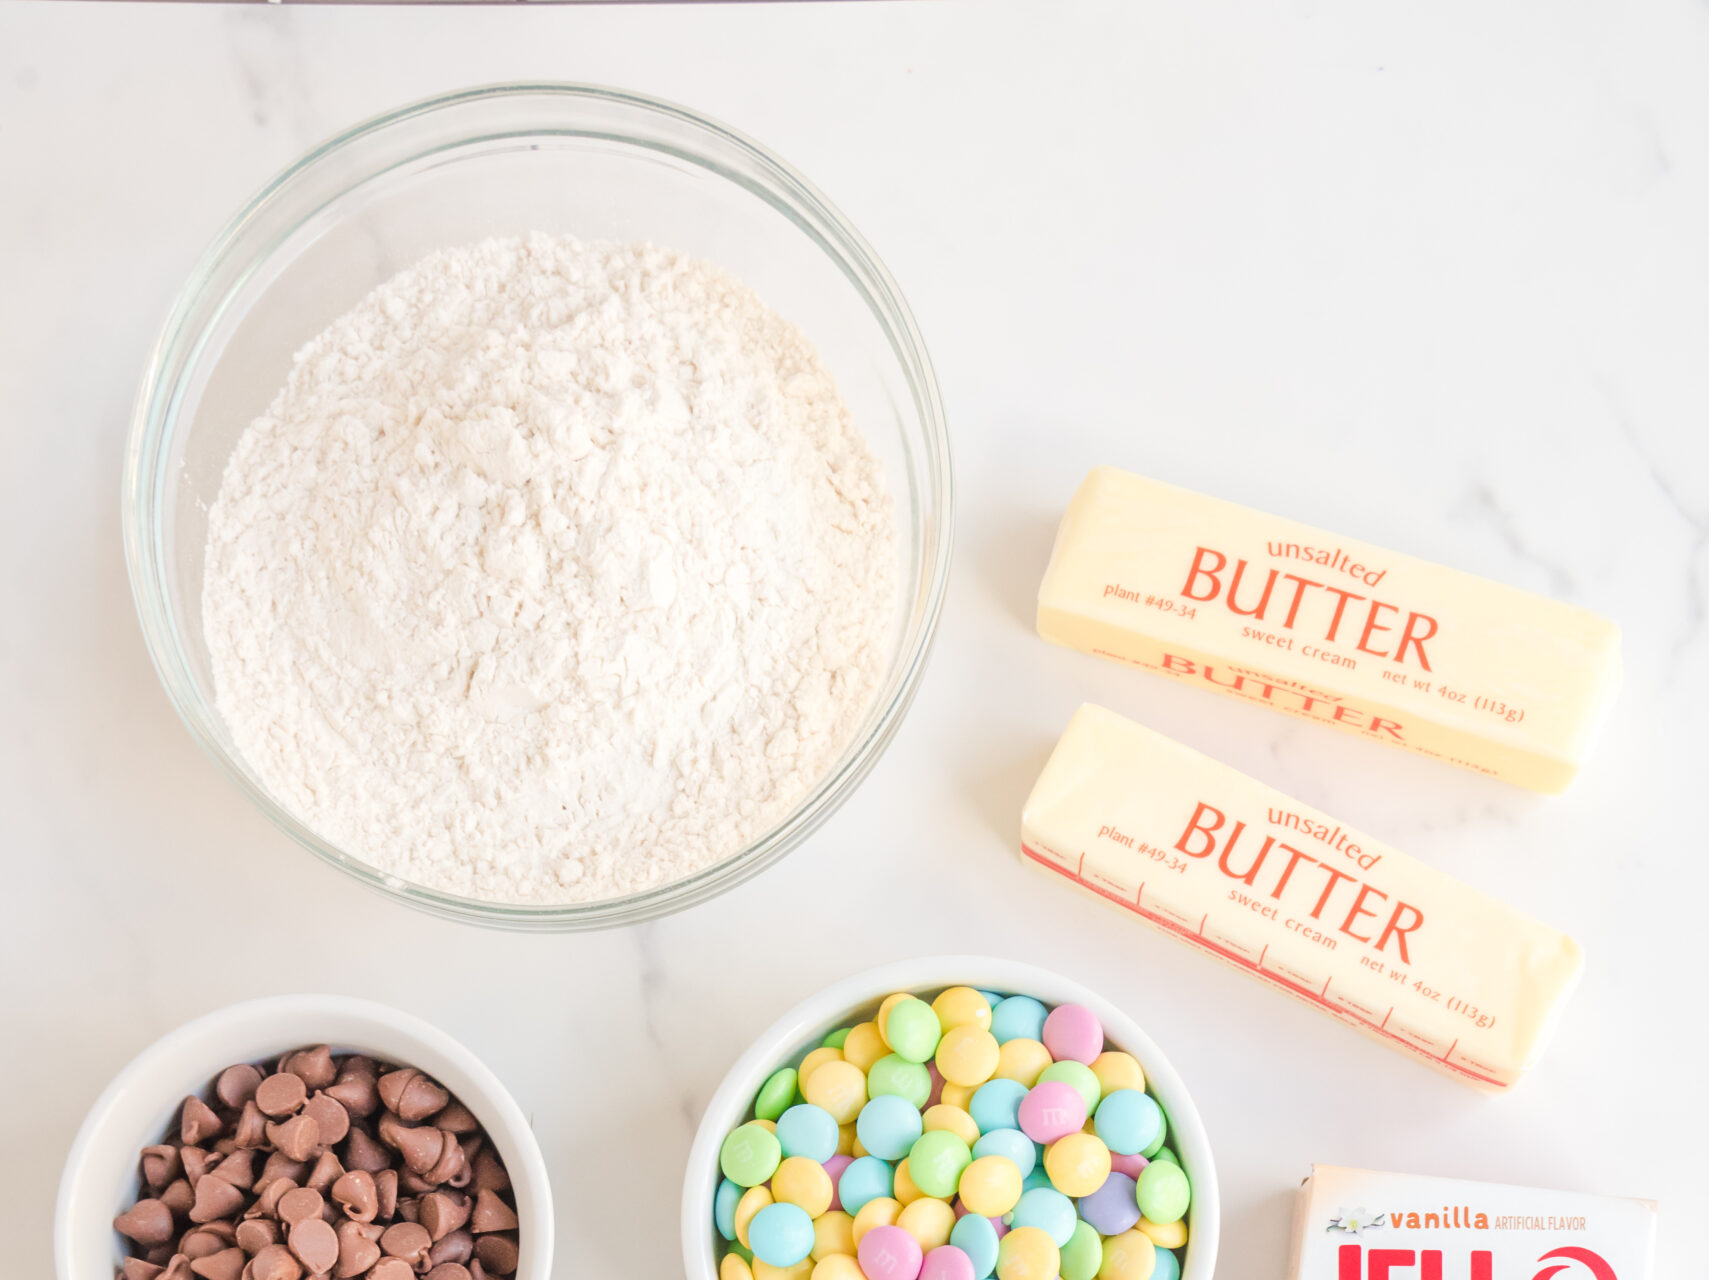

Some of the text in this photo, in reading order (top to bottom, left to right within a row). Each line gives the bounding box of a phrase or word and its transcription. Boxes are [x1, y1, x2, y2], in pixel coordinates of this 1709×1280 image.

[1267, 540, 1387, 589] unsalted
[1103, 582, 1197, 621] plant #49-34
[1180, 545, 1439, 673] BUTTER
[1241, 625, 1357, 671] sweet cream
[1161, 653, 1406, 741] BUTTER
[1227, 665, 1344, 703] unsalted
[1382, 669, 1525, 725] net wt 4oz (113g)
[1098, 824, 1188, 875] plant #49-34
[1267, 806, 1383, 871] unsalted
[1174, 801, 1424, 965] BUTTER
[1227, 887, 1278, 922] sweet
[1285, 916, 1337, 951] cream
[1361, 953, 1497, 1029] net wt 4oz (113g)
[1042, 1108, 1070, 1126] m
[732, 1137, 754, 1163] m
[1390, 1206, 1587, 1231] vanilla ARTIFICIAL FLAVOR
[874, 1248, 898, 1273] m
